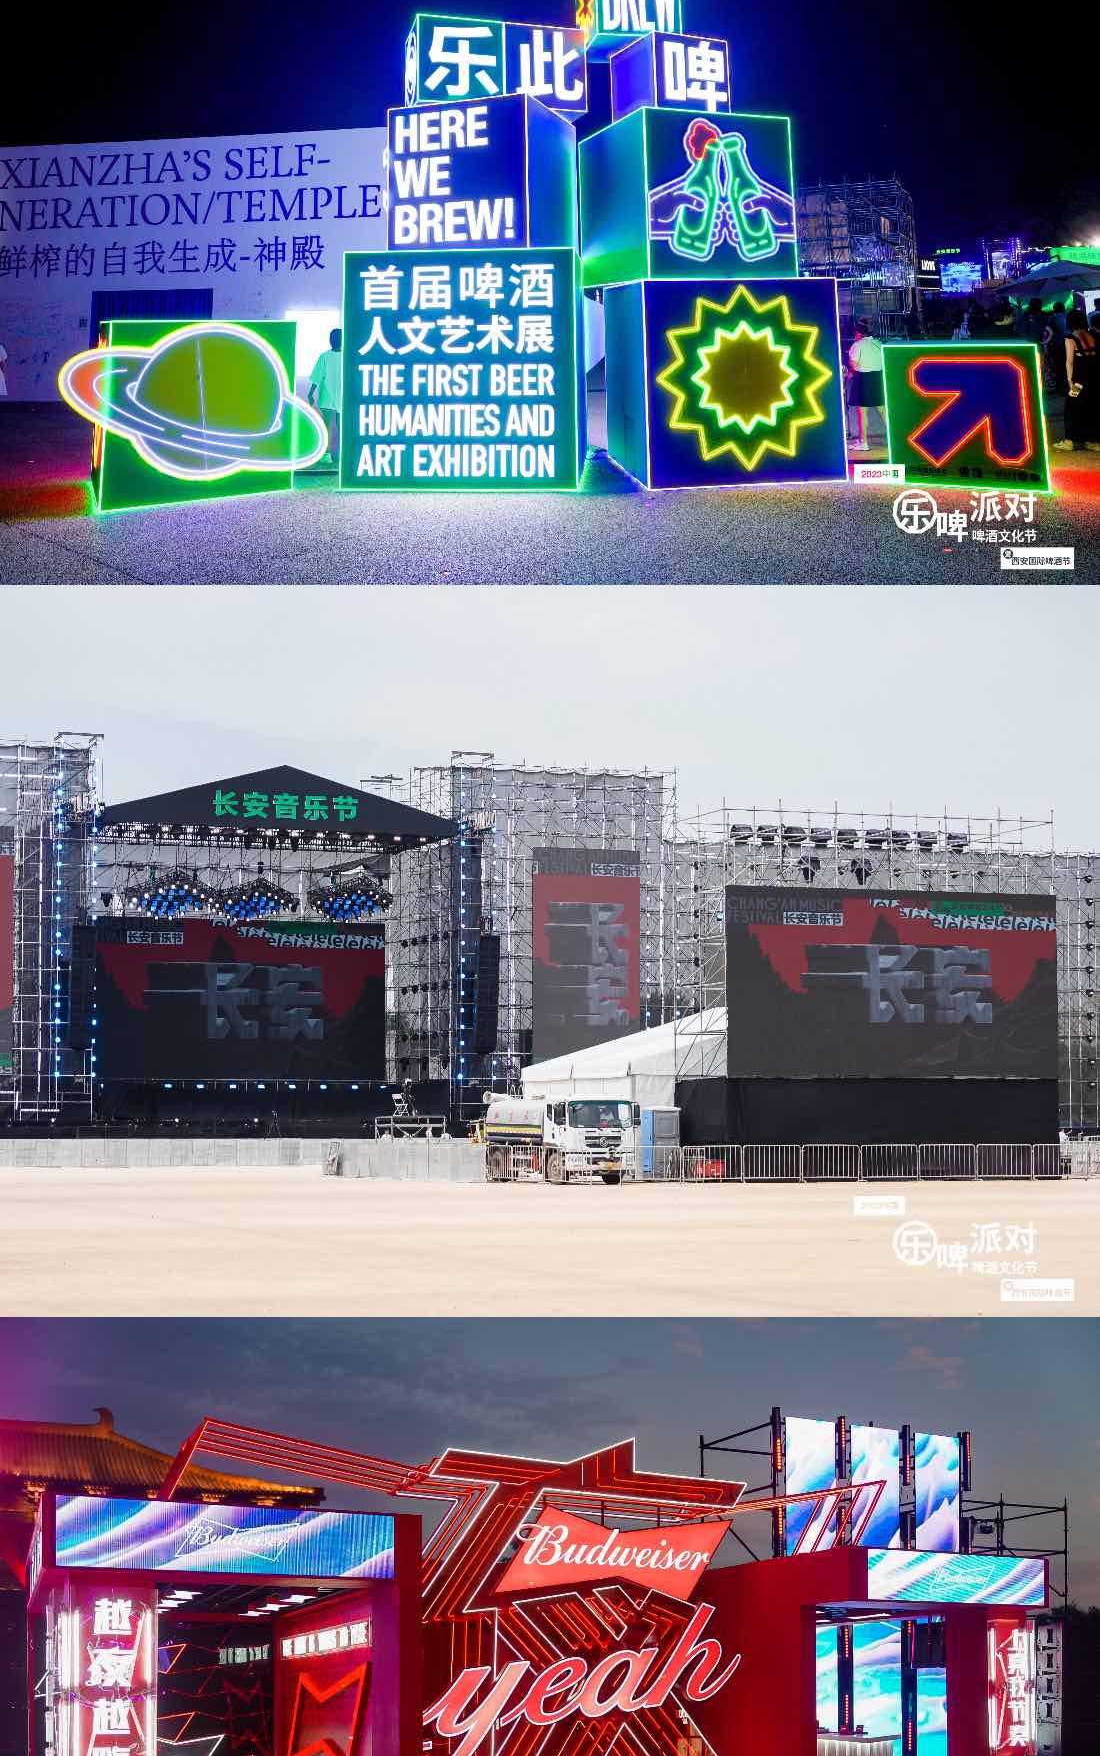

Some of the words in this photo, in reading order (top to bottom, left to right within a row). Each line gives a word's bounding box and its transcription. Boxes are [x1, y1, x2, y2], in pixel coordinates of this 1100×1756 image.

[663, 40, 728, 114] 啤
[393, 106, 490, 154] HERE
[224, 143, 331, 181] SELF-
[394, 156, 451, 199] WE
[394, 198, 515, 245] BREW!
[0, 235, 326, 278] 鲜榨的自我生成-神殿
[359, 262, 555, 311] 首届啤酒
[358, 314, 555, 356] 人文艺术展
[358, 364, 406, 397] THE
[412, 364, 483, 397] FIRST
[490, 363, 556, 396] BEER
[359, 404, 501, 437] HUMANITIES
[505, 404, 555, 437] AND
[356, 444, 406, 477] ART
[413, 444, 556, 478] EXHIBITION
[213, 789, 359, 822] 长安音乐节
[784, 913, 843, 925] 长安音乐节
[517, 1523, 711, 1572] Budweiser
